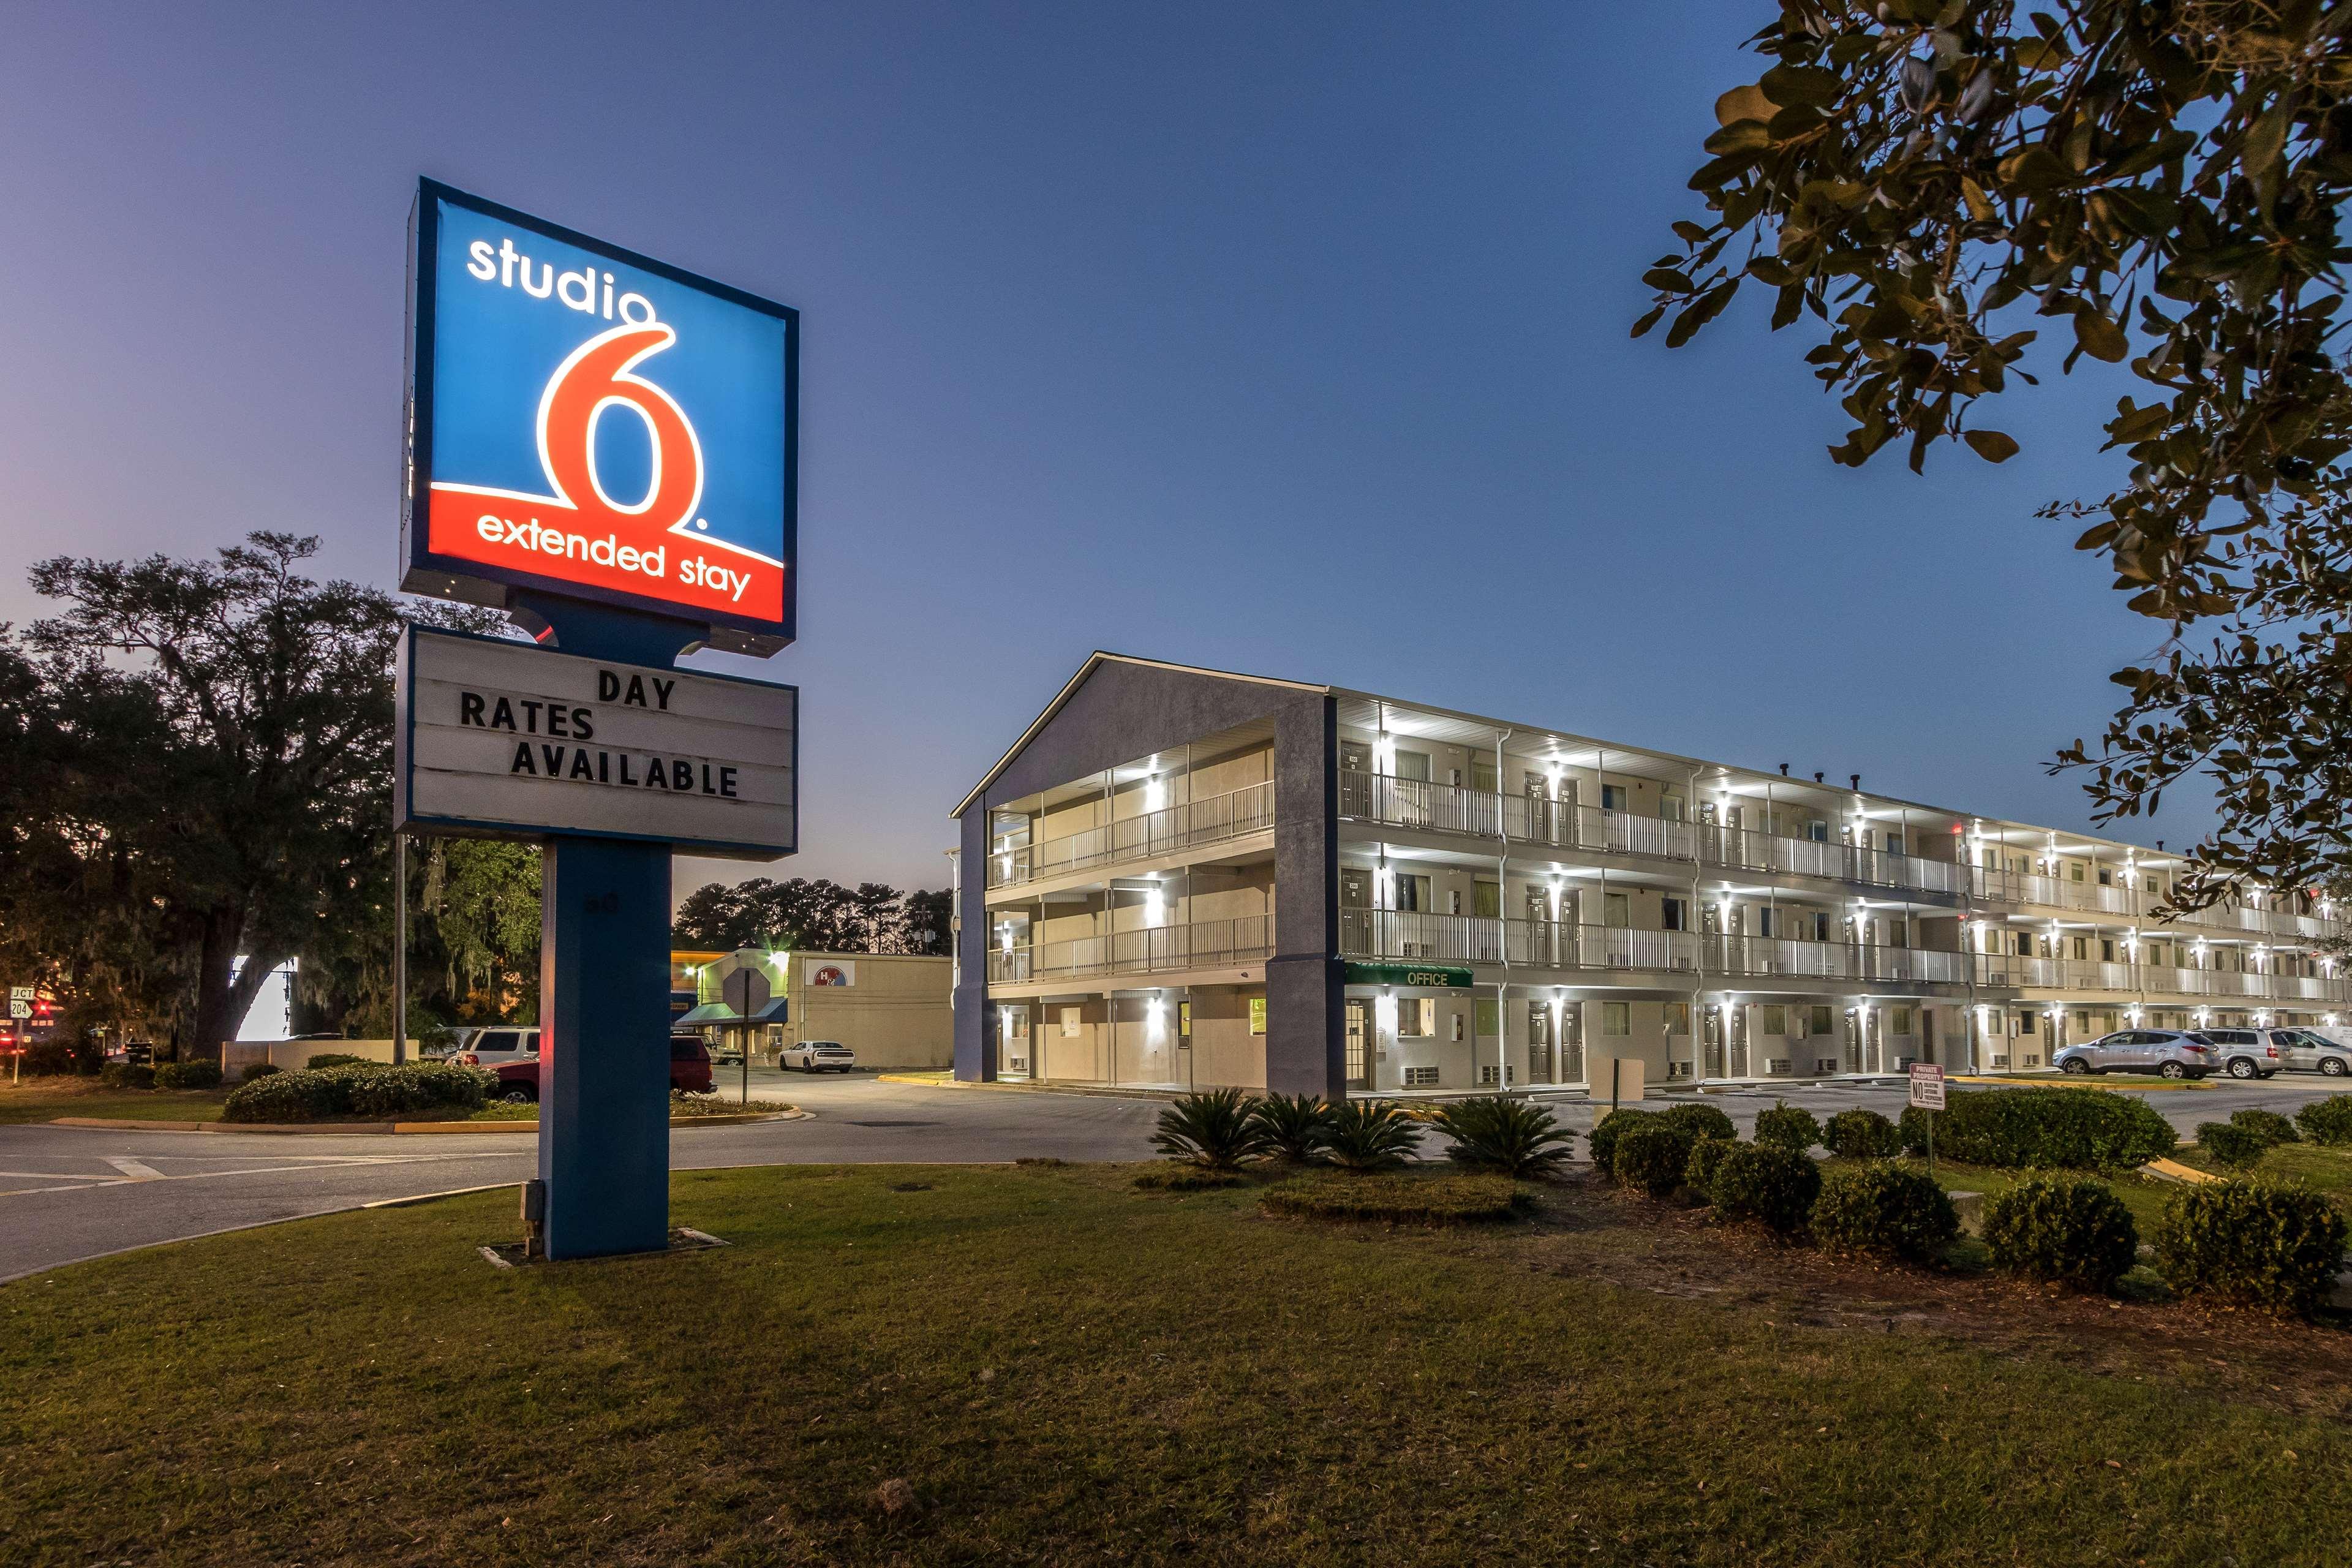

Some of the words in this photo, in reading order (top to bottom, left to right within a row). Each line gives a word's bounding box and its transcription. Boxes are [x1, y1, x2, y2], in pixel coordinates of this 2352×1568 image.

[467, 238, 657, 326] studio
[536, 322, 704, 532] 6
[477, 514, 665, 578] extended
[679, 555, 752, 602] stay
[598, 669, 676, 710] DAY
[461, 691, 594, 741] RATES
[511, 741, 737, 797] AVAILABLE
[13, 989, 32, 998] JCT
[821, 971, 828, 980] H
[1408, 972, 1448, 986] OFFICE
[12, 1004, 27, 1014] 204
[1912, 1082, 1923, 1099] NO
